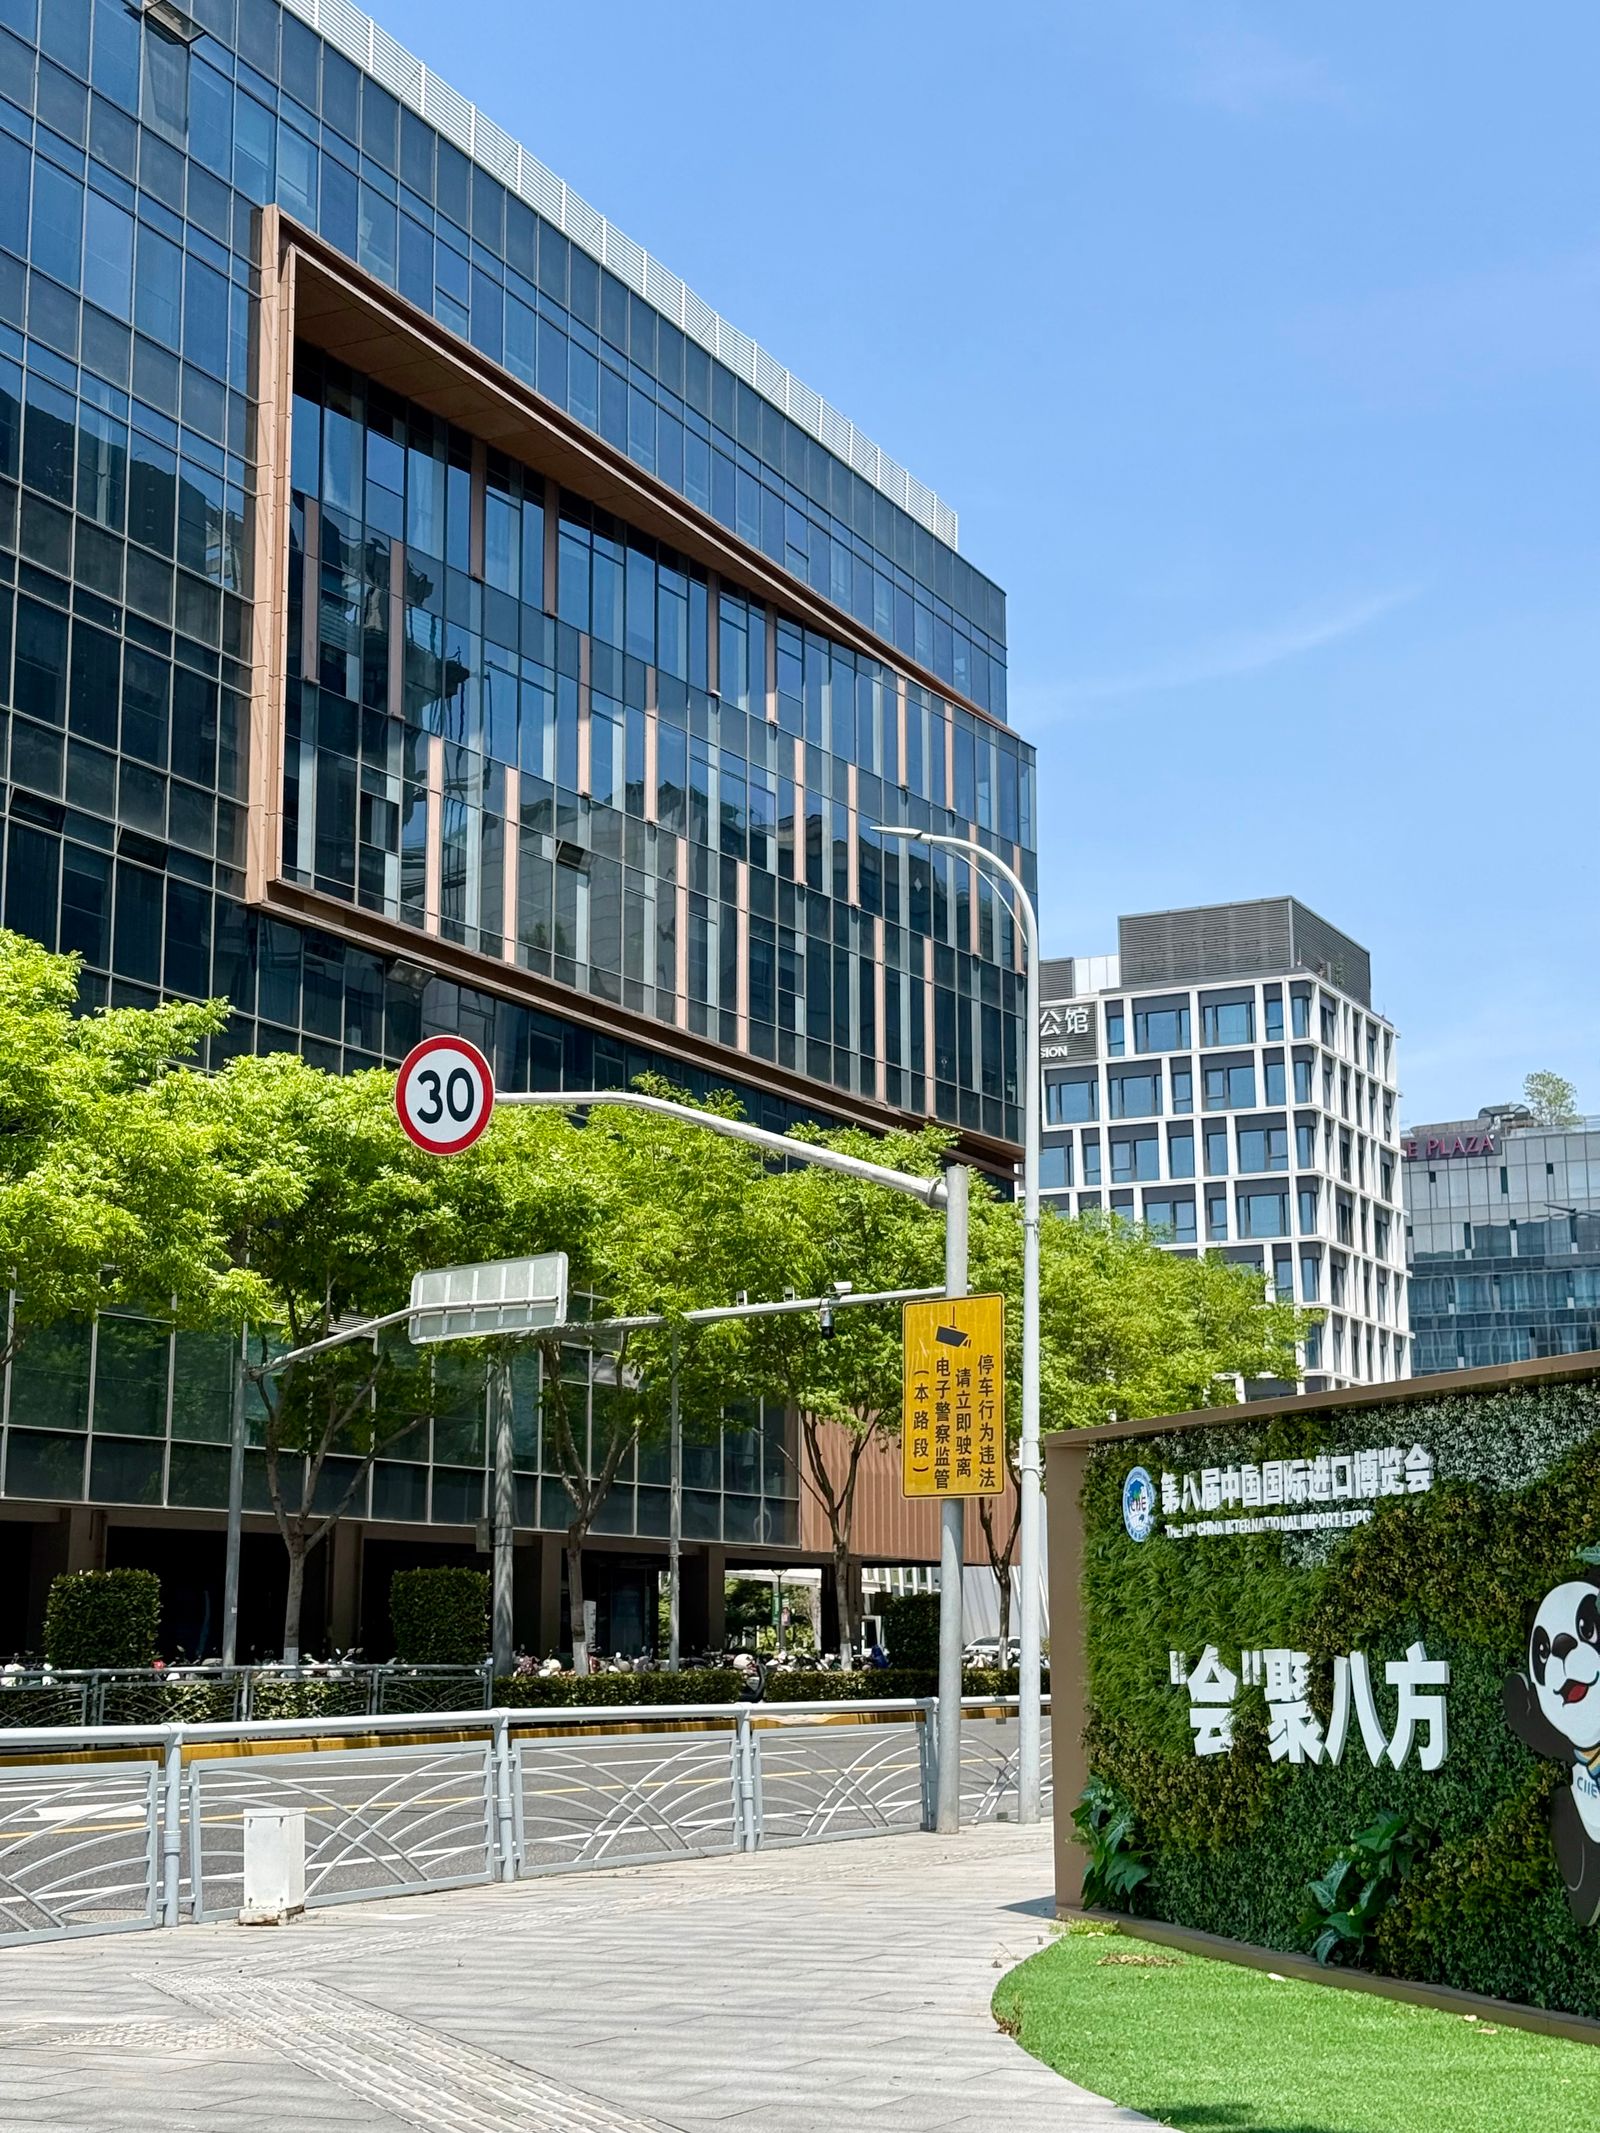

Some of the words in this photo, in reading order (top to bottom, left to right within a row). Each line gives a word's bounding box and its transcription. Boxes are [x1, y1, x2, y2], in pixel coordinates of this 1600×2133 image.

[1040, 1007, 1089, 1036] 公馆
[417, 1067, 475, 1124] 30
[1427, 1133, 1495, 1156] PLAZA
[934, 1356, 951, 1490] 电子警察监管
[955, 1367, 972, 1478] 请立即驶离
[977, 1354, 996, 1489] 停车行为违法
[1161, 1443, 1434, 1515] 第八届中国国际进口博览会
[1196, 1520, 1225, 1536] CHINA
[1225, 1512, 1300, 1534] INTERNATIONAL
[1300, 1511, 1341, 1530] IMPORT
[1341, 1509, 1373, 1528] EXPO
[1576, 1776, 1598, 1799] CIIE
